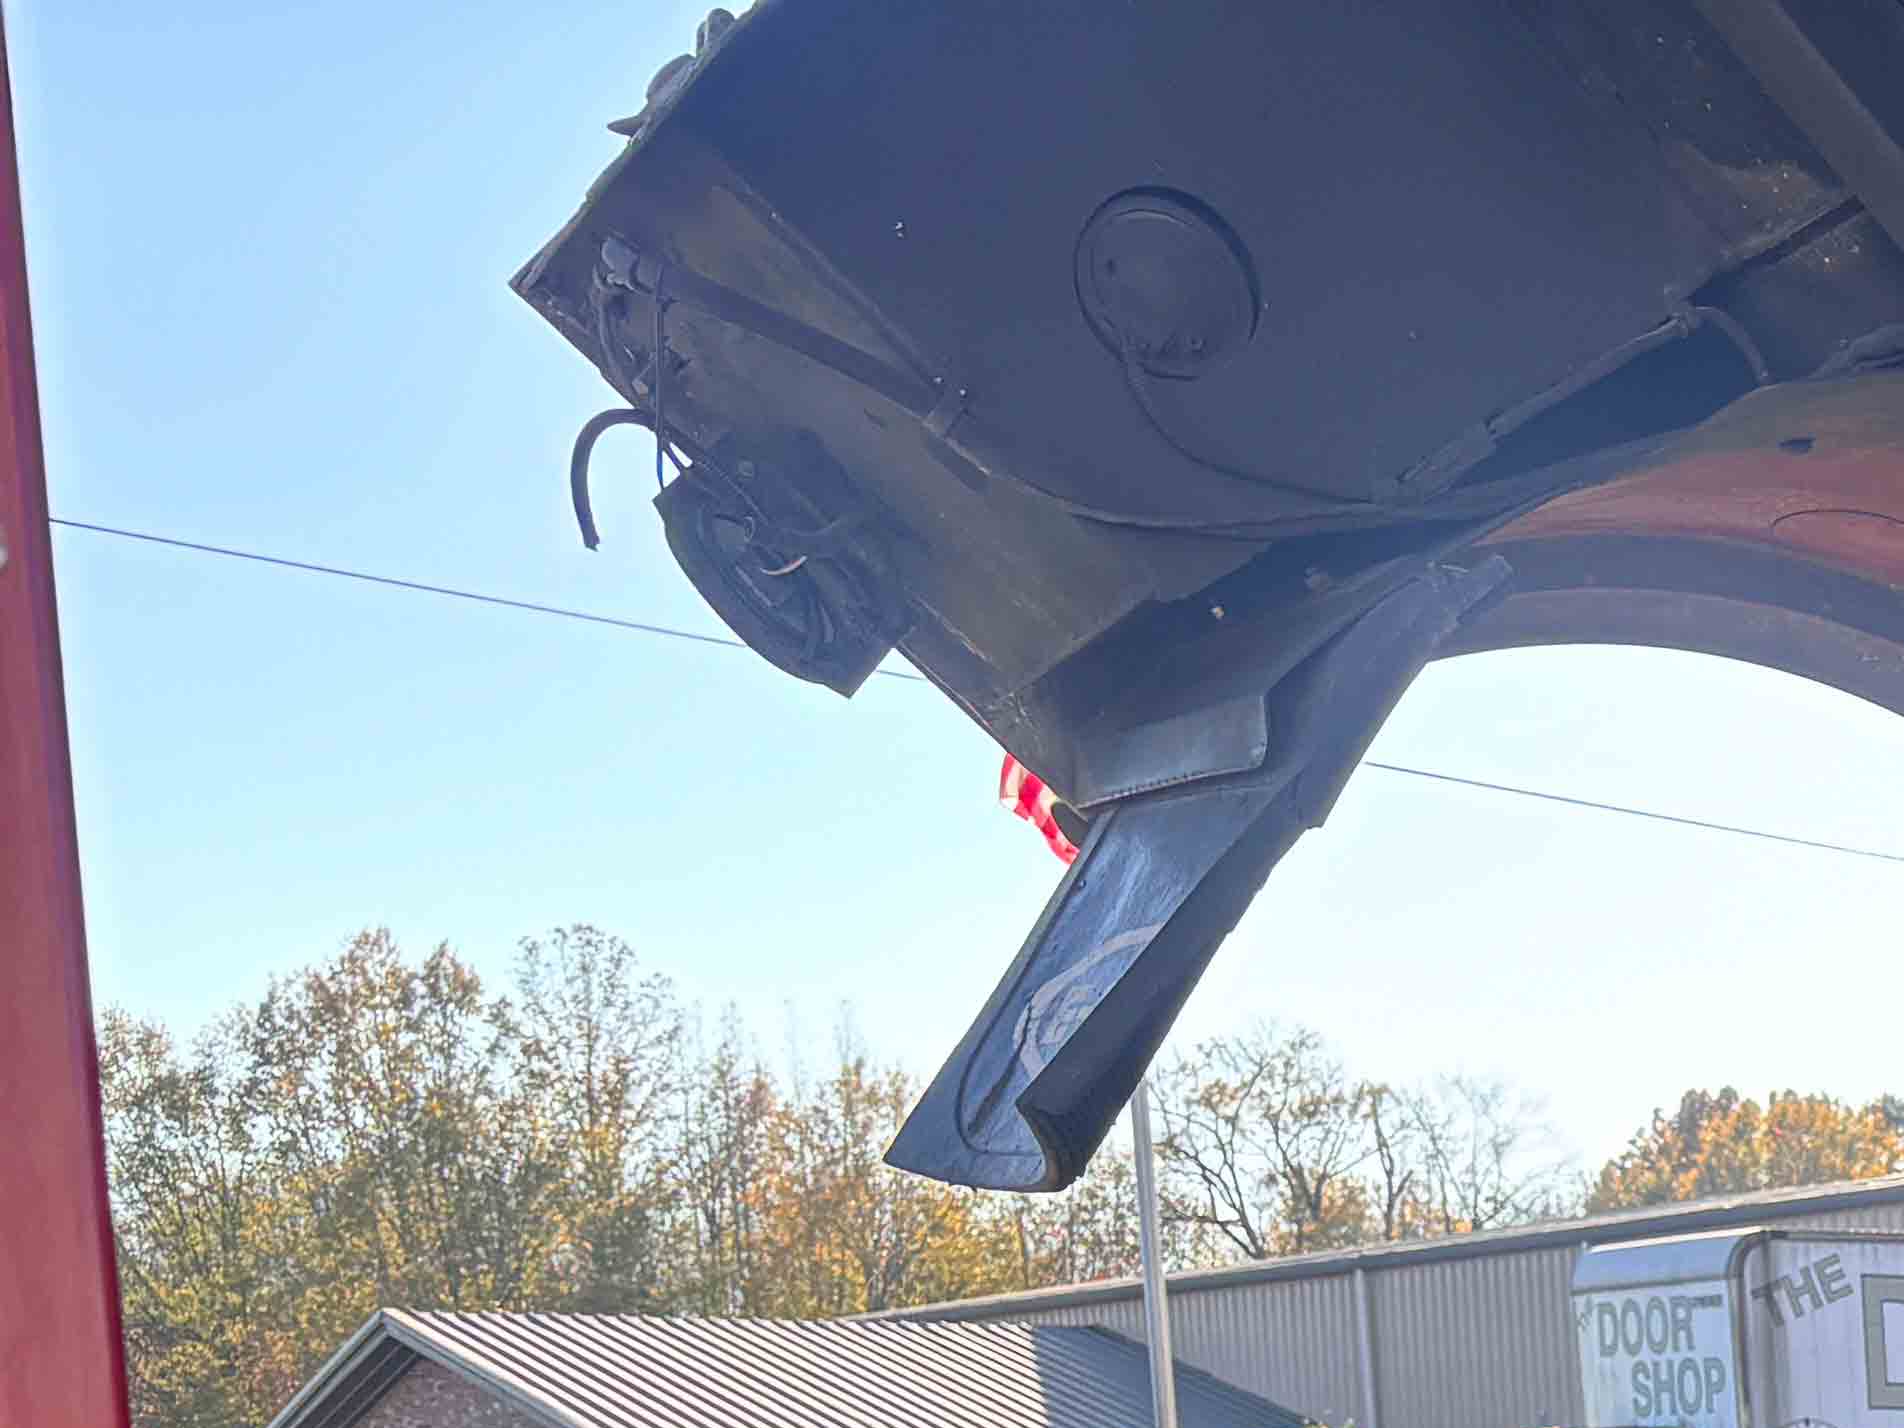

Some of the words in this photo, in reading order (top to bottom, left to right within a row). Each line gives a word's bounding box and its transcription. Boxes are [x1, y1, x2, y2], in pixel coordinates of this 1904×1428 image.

[1751, 1252, 1855, 1329] THE
[1597, 1297, 1696, 1357] DOOR
[1631, 1357, 1727, 1418] SHOP
